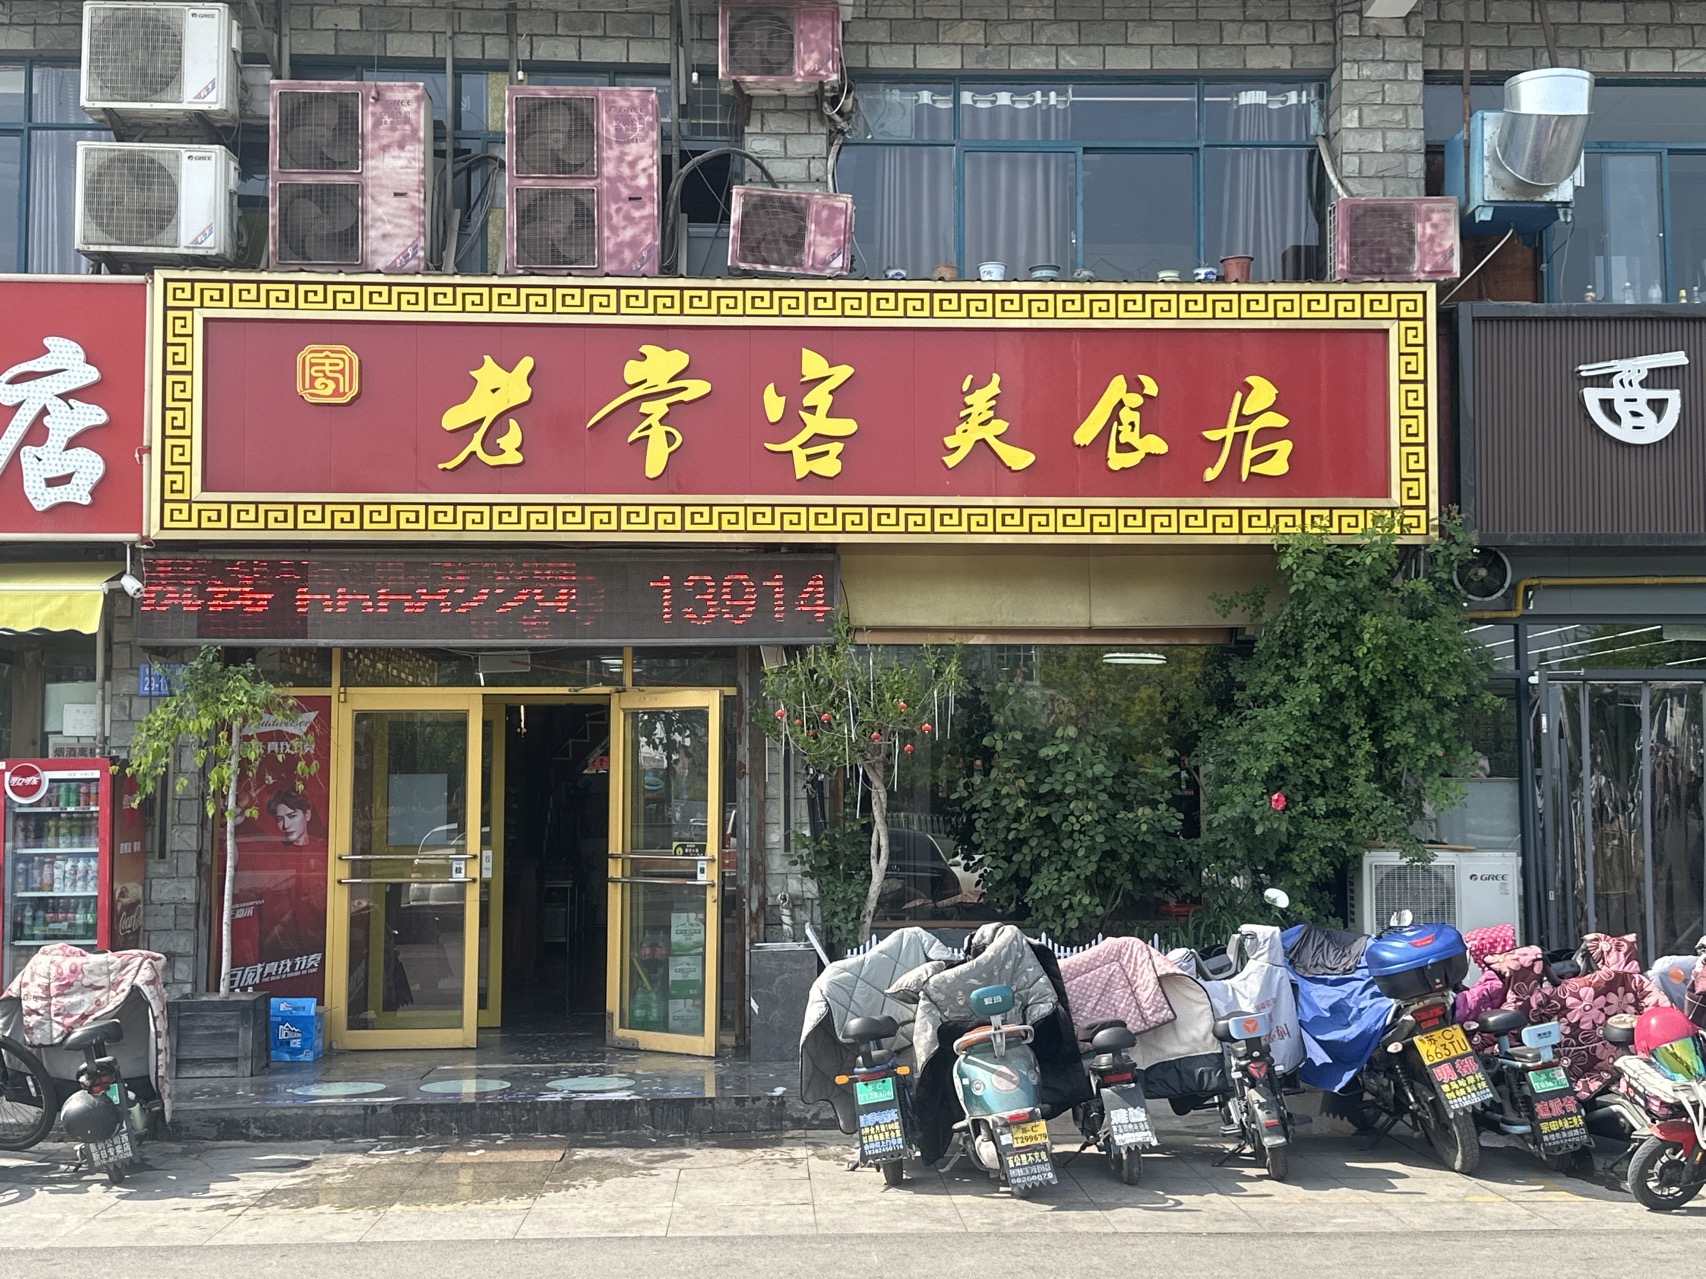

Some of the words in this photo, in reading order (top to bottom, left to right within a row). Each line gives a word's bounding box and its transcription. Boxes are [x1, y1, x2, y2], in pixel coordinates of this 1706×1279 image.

[0, 336, 108, 511] 店
[438, 344, 1293, 481] 老常客美食居
[1426, 1038, 1468, 1062] 663TU
[1432, 1056, 1479, 1082] 明都
[1014, 1133, 1048, 1144] T299679
